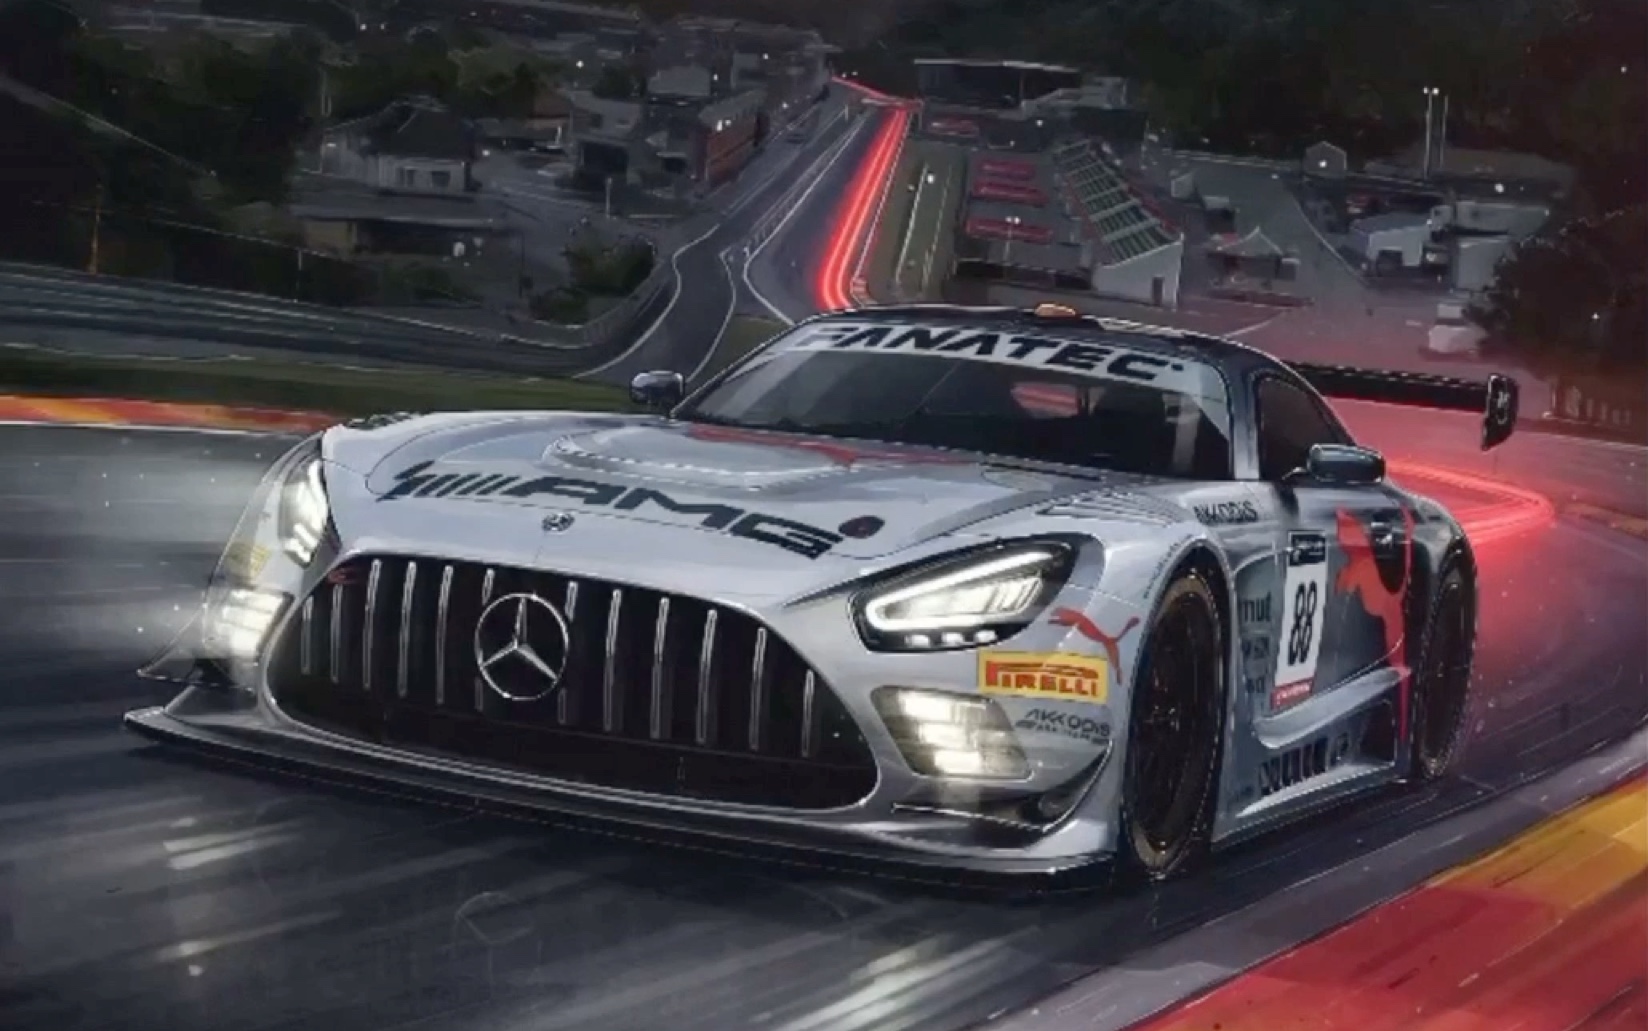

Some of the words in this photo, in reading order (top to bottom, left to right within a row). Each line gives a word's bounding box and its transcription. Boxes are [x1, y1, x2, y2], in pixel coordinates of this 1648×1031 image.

[796, 325, 1171, 381] FANATEC
[506, 476, 844, 560] AMG
[1288, 581, 1318, 666] 88
[985, 660, 1099, 697] PIRELLI
